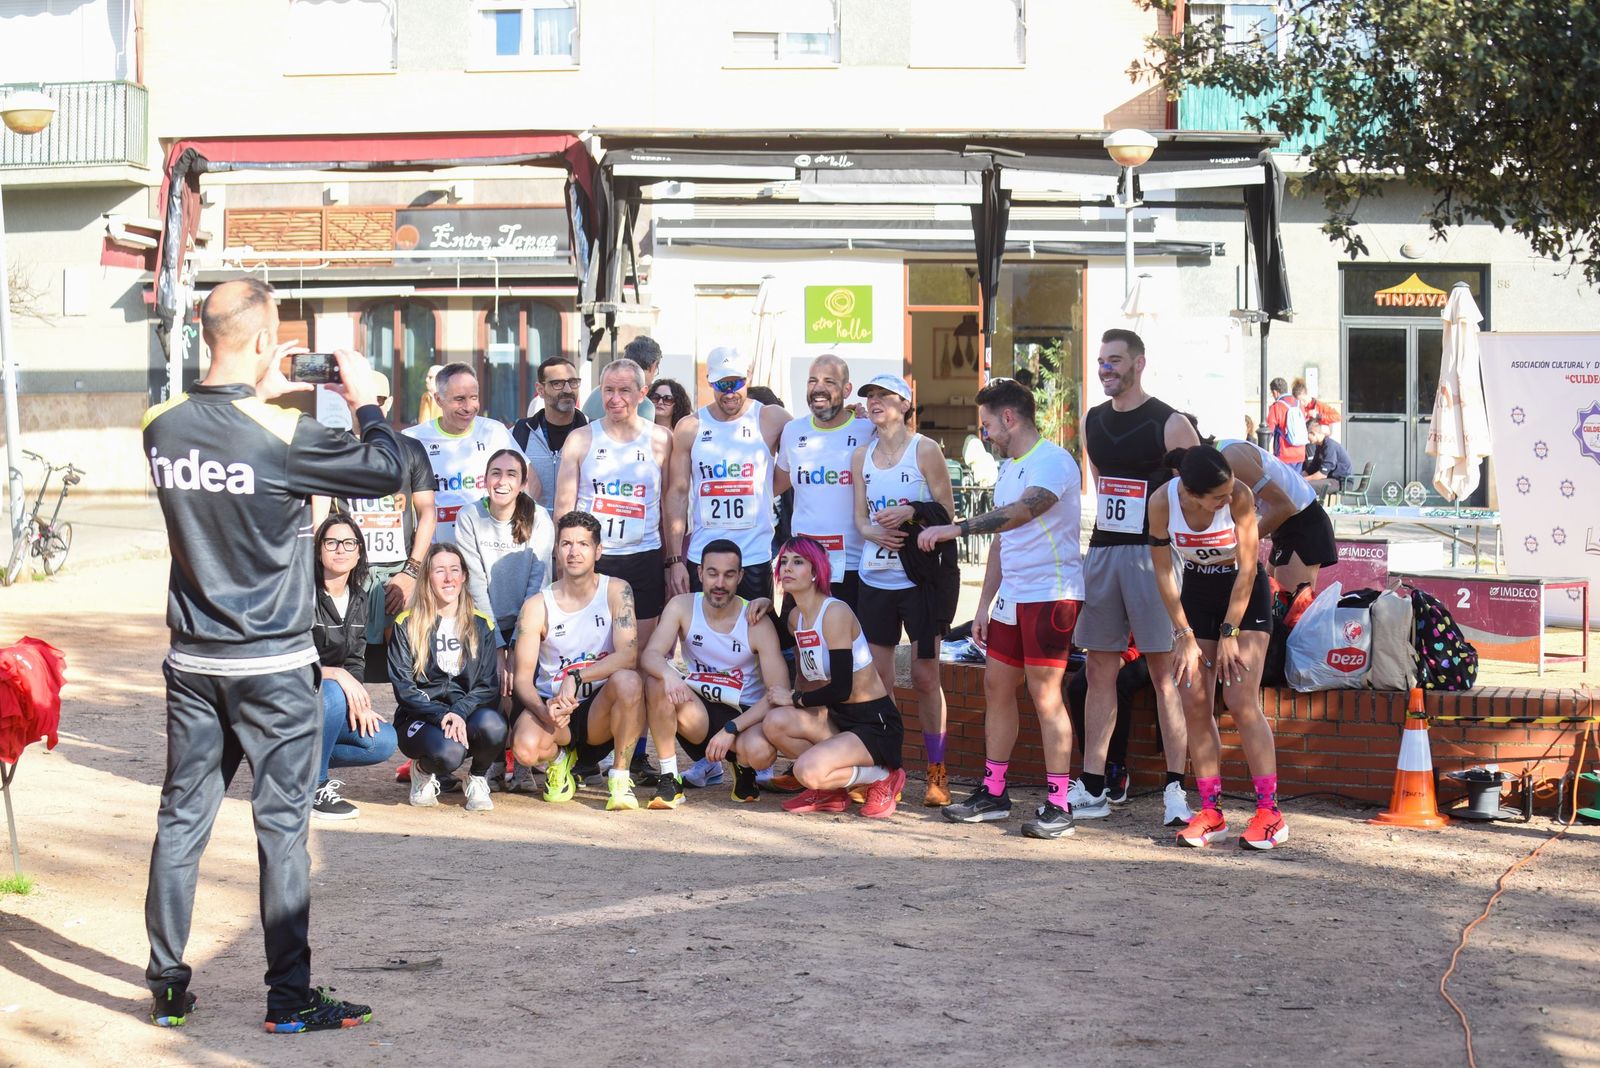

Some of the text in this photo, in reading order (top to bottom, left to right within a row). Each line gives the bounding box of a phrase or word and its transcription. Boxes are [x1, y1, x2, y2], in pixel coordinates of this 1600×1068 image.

[429, 222, 492, 249] Entre
[1374, 292, 1449, 307] TINDAYA
[1510, 360, 1550, 369] ASOCIACIÓN
[1551, 361, 1584, 369] CULTURAL
[151, 446, 255, 495] indea
[699, 459, 755, 479] indea
[797, 466, 853, 486] indea
[592, 478, 647, 498] indea
[711, 498, 744, 519] 216
[1105, 497, 1126, 521] 66
[607, 517, 626, 539] 11
[364, 531, 395, 552] 153
[1348, 547, 1385, 559] IMDECO
[1197, 564, 1232, 575] NIKE
[1456, 587, 1471, 609] 2
[1500, 586, 1538, 599] IMDECO
[1331, 652, 1364, 665] Deza
[701, 684, 722, 702] 69
